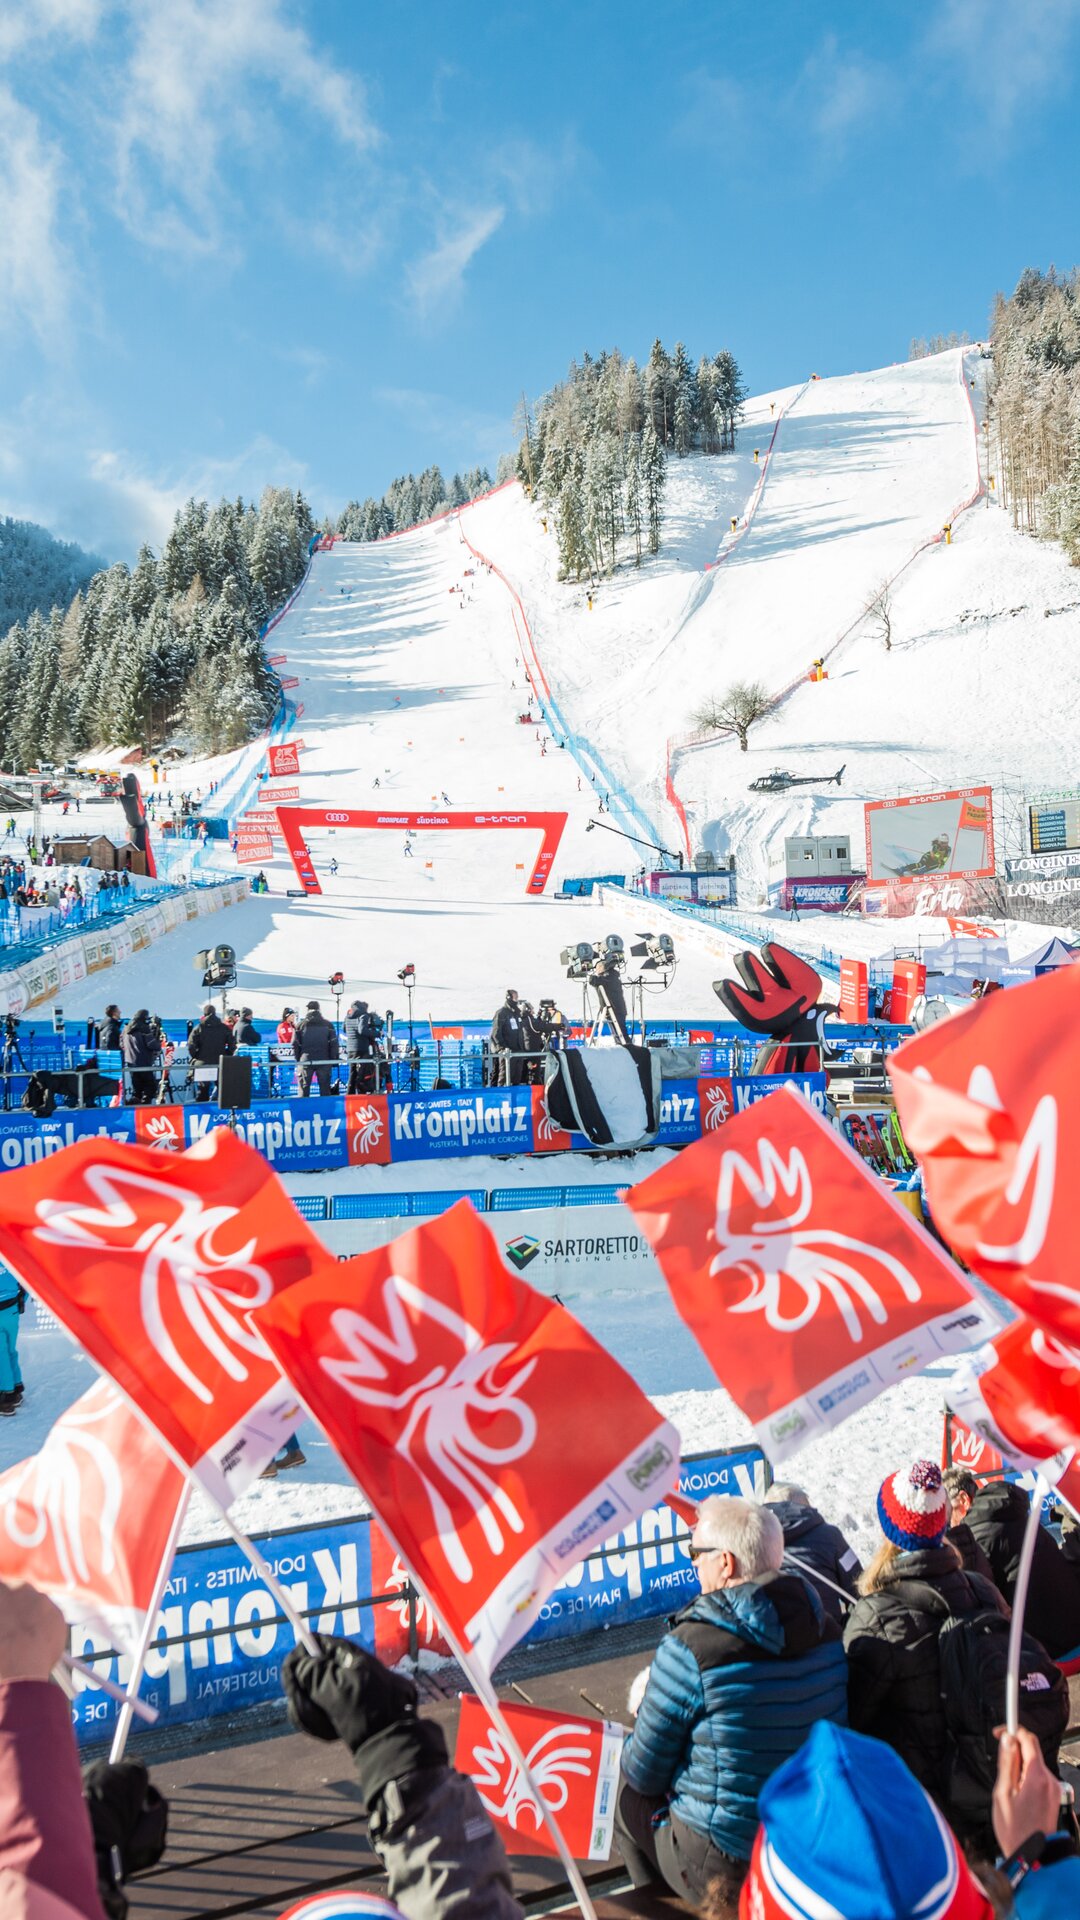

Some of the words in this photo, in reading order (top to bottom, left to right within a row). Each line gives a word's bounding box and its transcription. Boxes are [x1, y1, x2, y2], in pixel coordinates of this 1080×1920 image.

[268, 788, 300, 800] GENERALI
[909, 794, 946, 804] e-tron
[474, 815, 527, 824] e-tron
[1010, 854, 1080, 872] LONGINE
[912, 874, 950, 882] e-tron
[795, 886, 846, 898] KRONPLATZ
[457, 1099, 473, 1107] ITALY
[394, 1097, 527, 1146] Kronplatz
[42, 1123, 62, 1132] ITALY
[670, 1125, 696, 1134] CORONES
[189, 1110, 341, 1160] Knplatz
[430, 1140, 460, 1148] PUSTERTAL
[498, 1135, 528, 1143] CORONES
[308, 1149, 343, 1158] CORONES
[544, 1255, 611, 1264] STAGING
